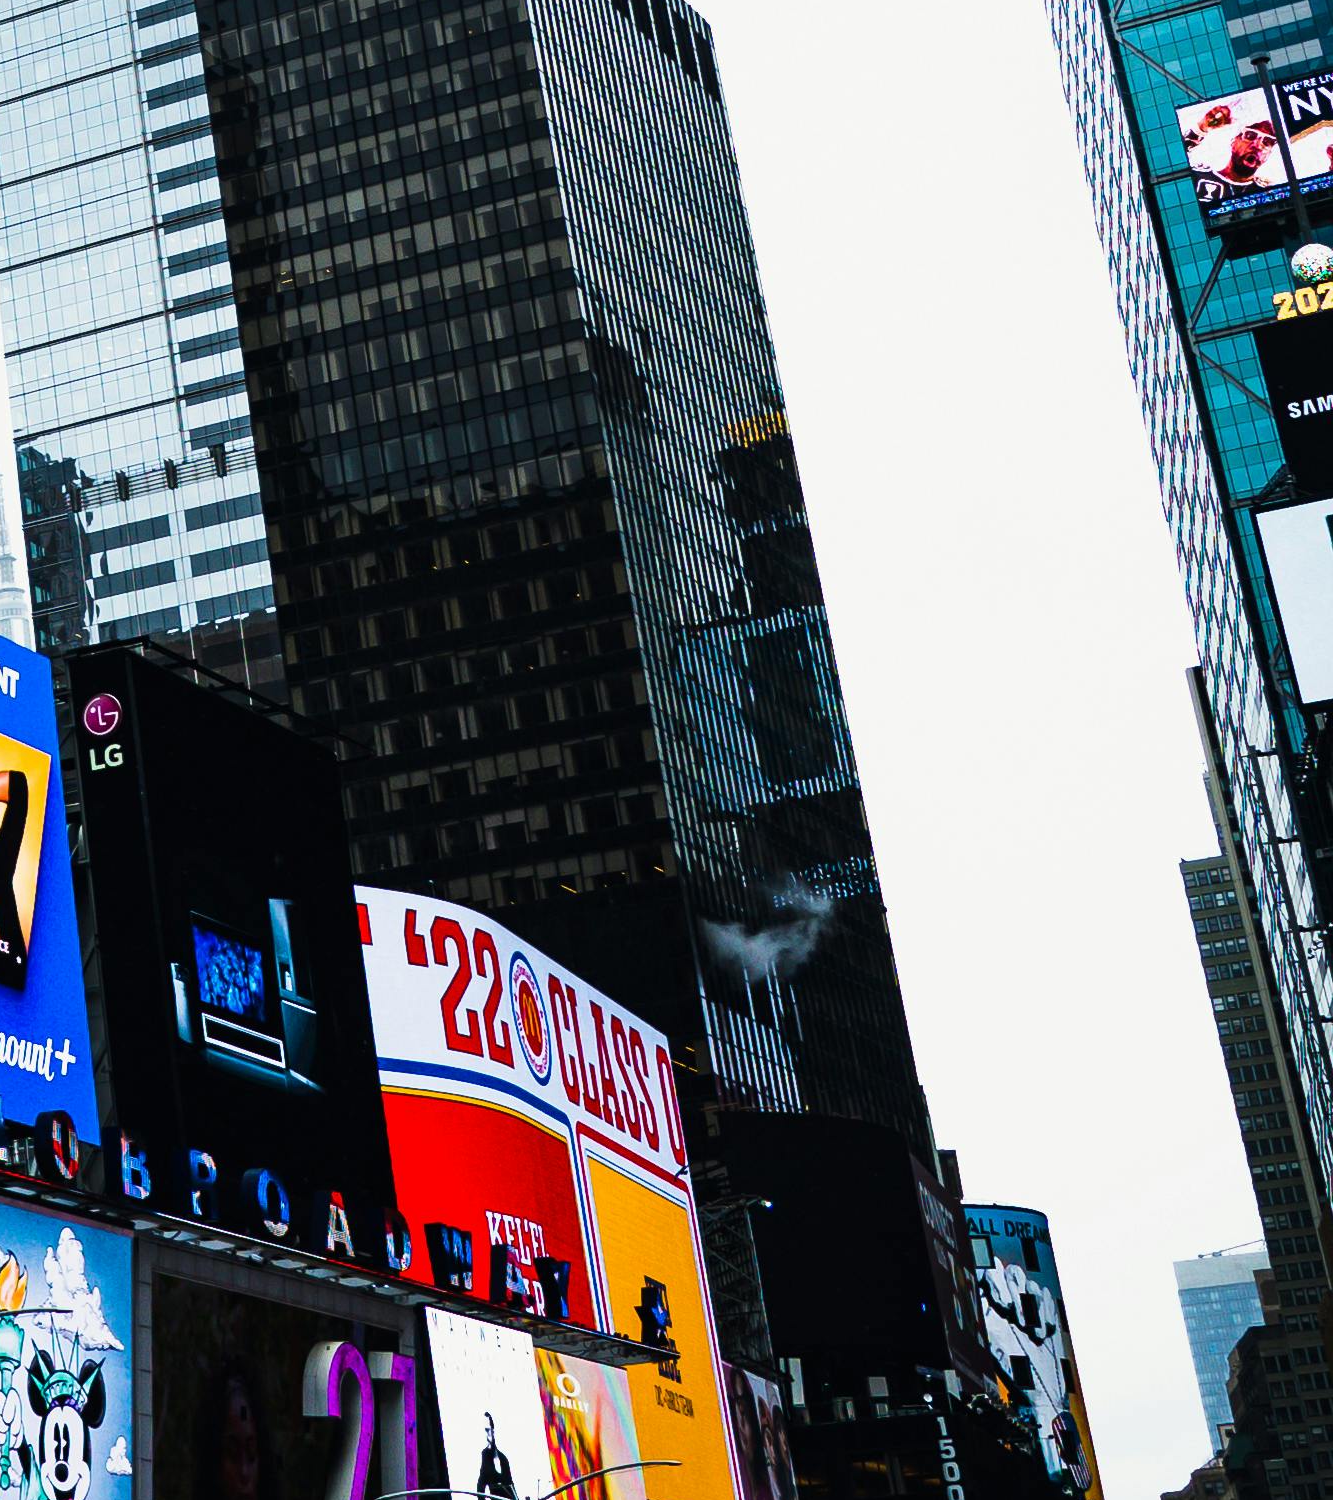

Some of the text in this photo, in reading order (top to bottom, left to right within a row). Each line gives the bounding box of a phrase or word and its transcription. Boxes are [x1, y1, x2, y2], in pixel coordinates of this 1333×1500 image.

[89, 743, 124, 772] LG
[548, 973, 661, 1151] CLASS
[966, 1217, 1001, 1237] ALL
